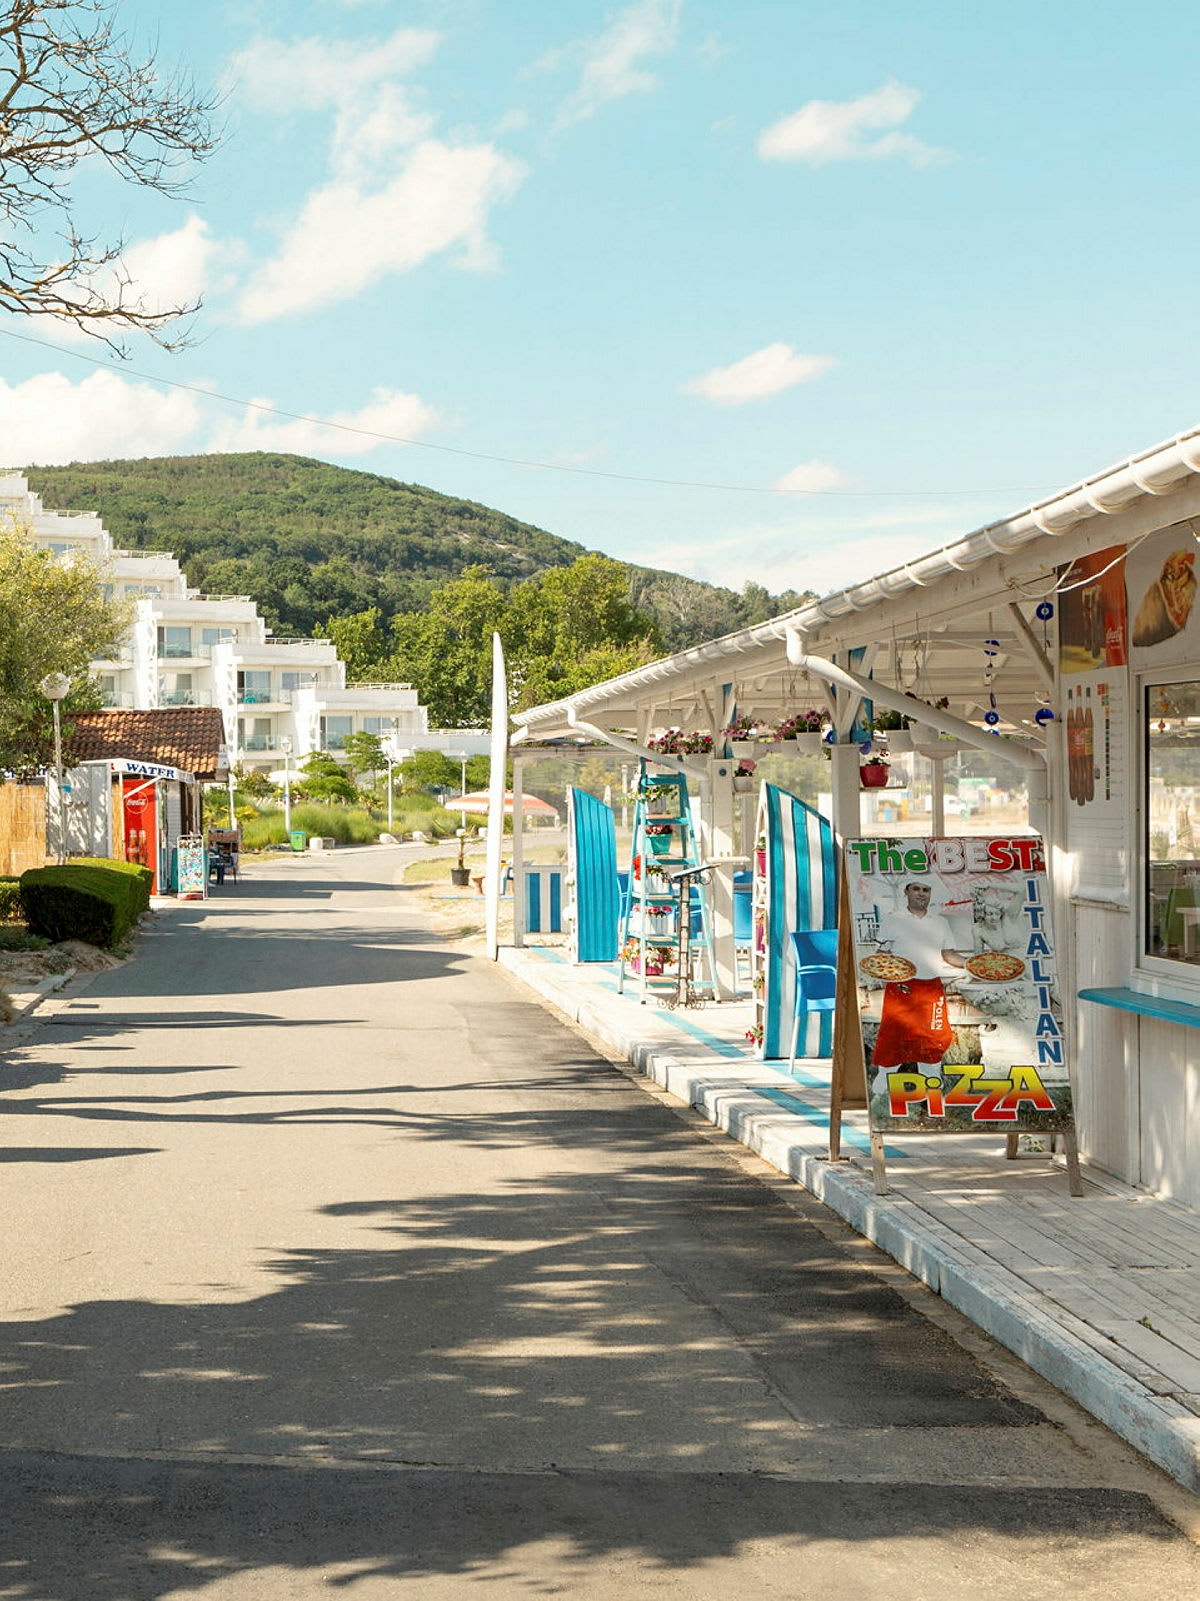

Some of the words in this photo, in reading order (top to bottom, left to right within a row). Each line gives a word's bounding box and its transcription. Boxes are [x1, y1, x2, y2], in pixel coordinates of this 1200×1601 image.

[126, 762, 175, 778] WATER
[851, 840, 927, 872] The
[935, 840, 1038, 872] BEST
[1023, 879, 1064, 1064] ITALIAN
